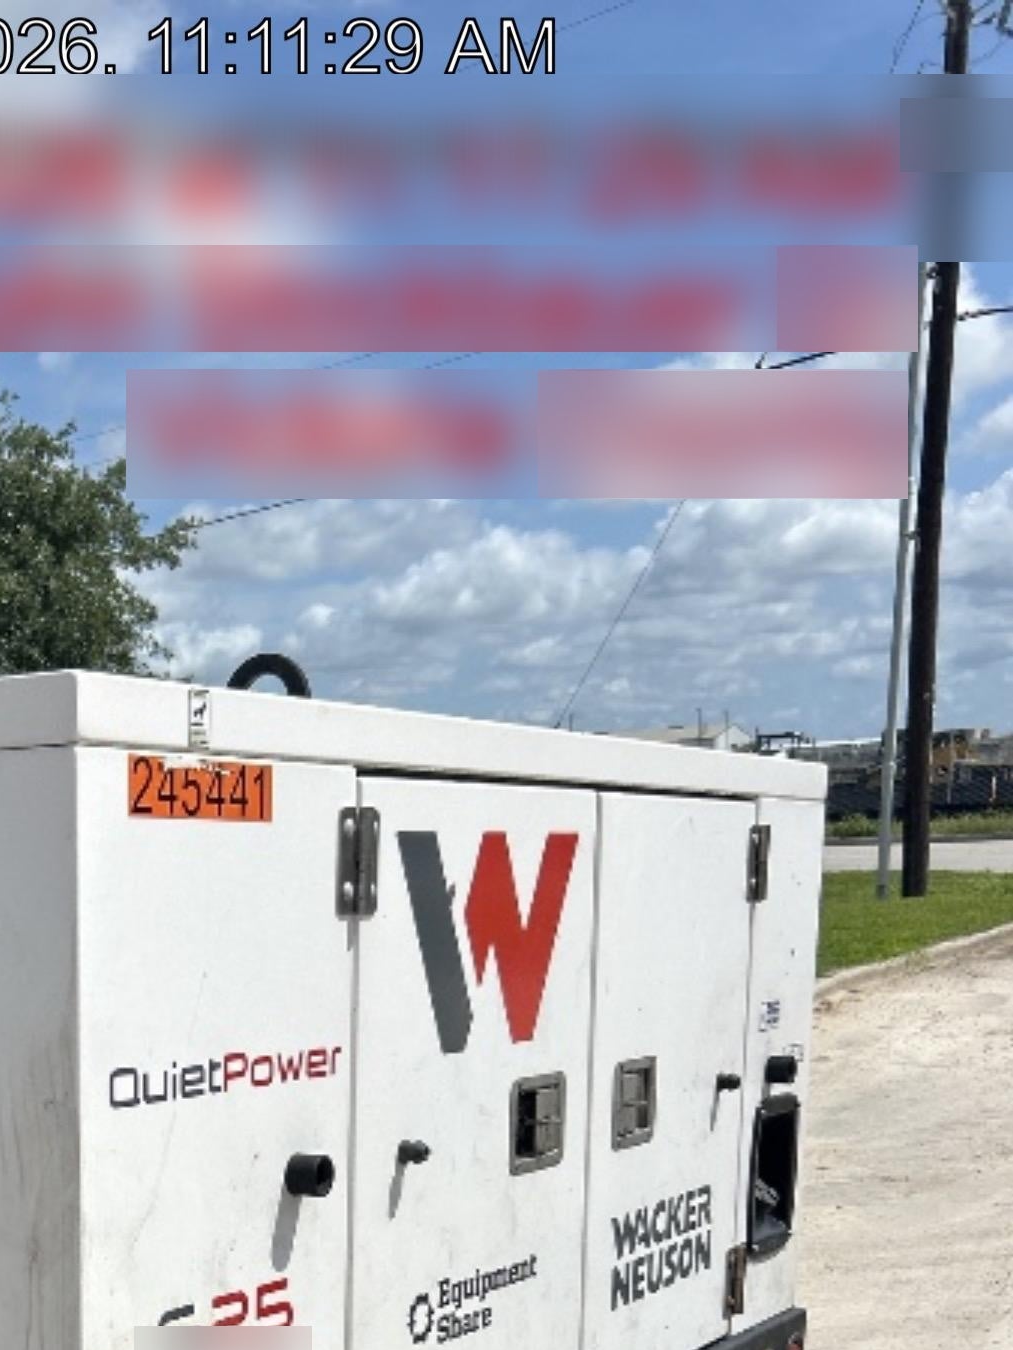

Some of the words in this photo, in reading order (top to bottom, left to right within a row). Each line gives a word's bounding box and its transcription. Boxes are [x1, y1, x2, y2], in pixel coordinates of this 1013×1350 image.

[131, 756, 265, 819] 245441
[109, 1047, 342, 1107] QuietPower
[610, 1184, 712, 1260] WACKER
[437, 1254, 537, 1309] Equipment
[610, 1229, 712, 1311] NEUSON
[437, 1307, 493, 1344] Share
